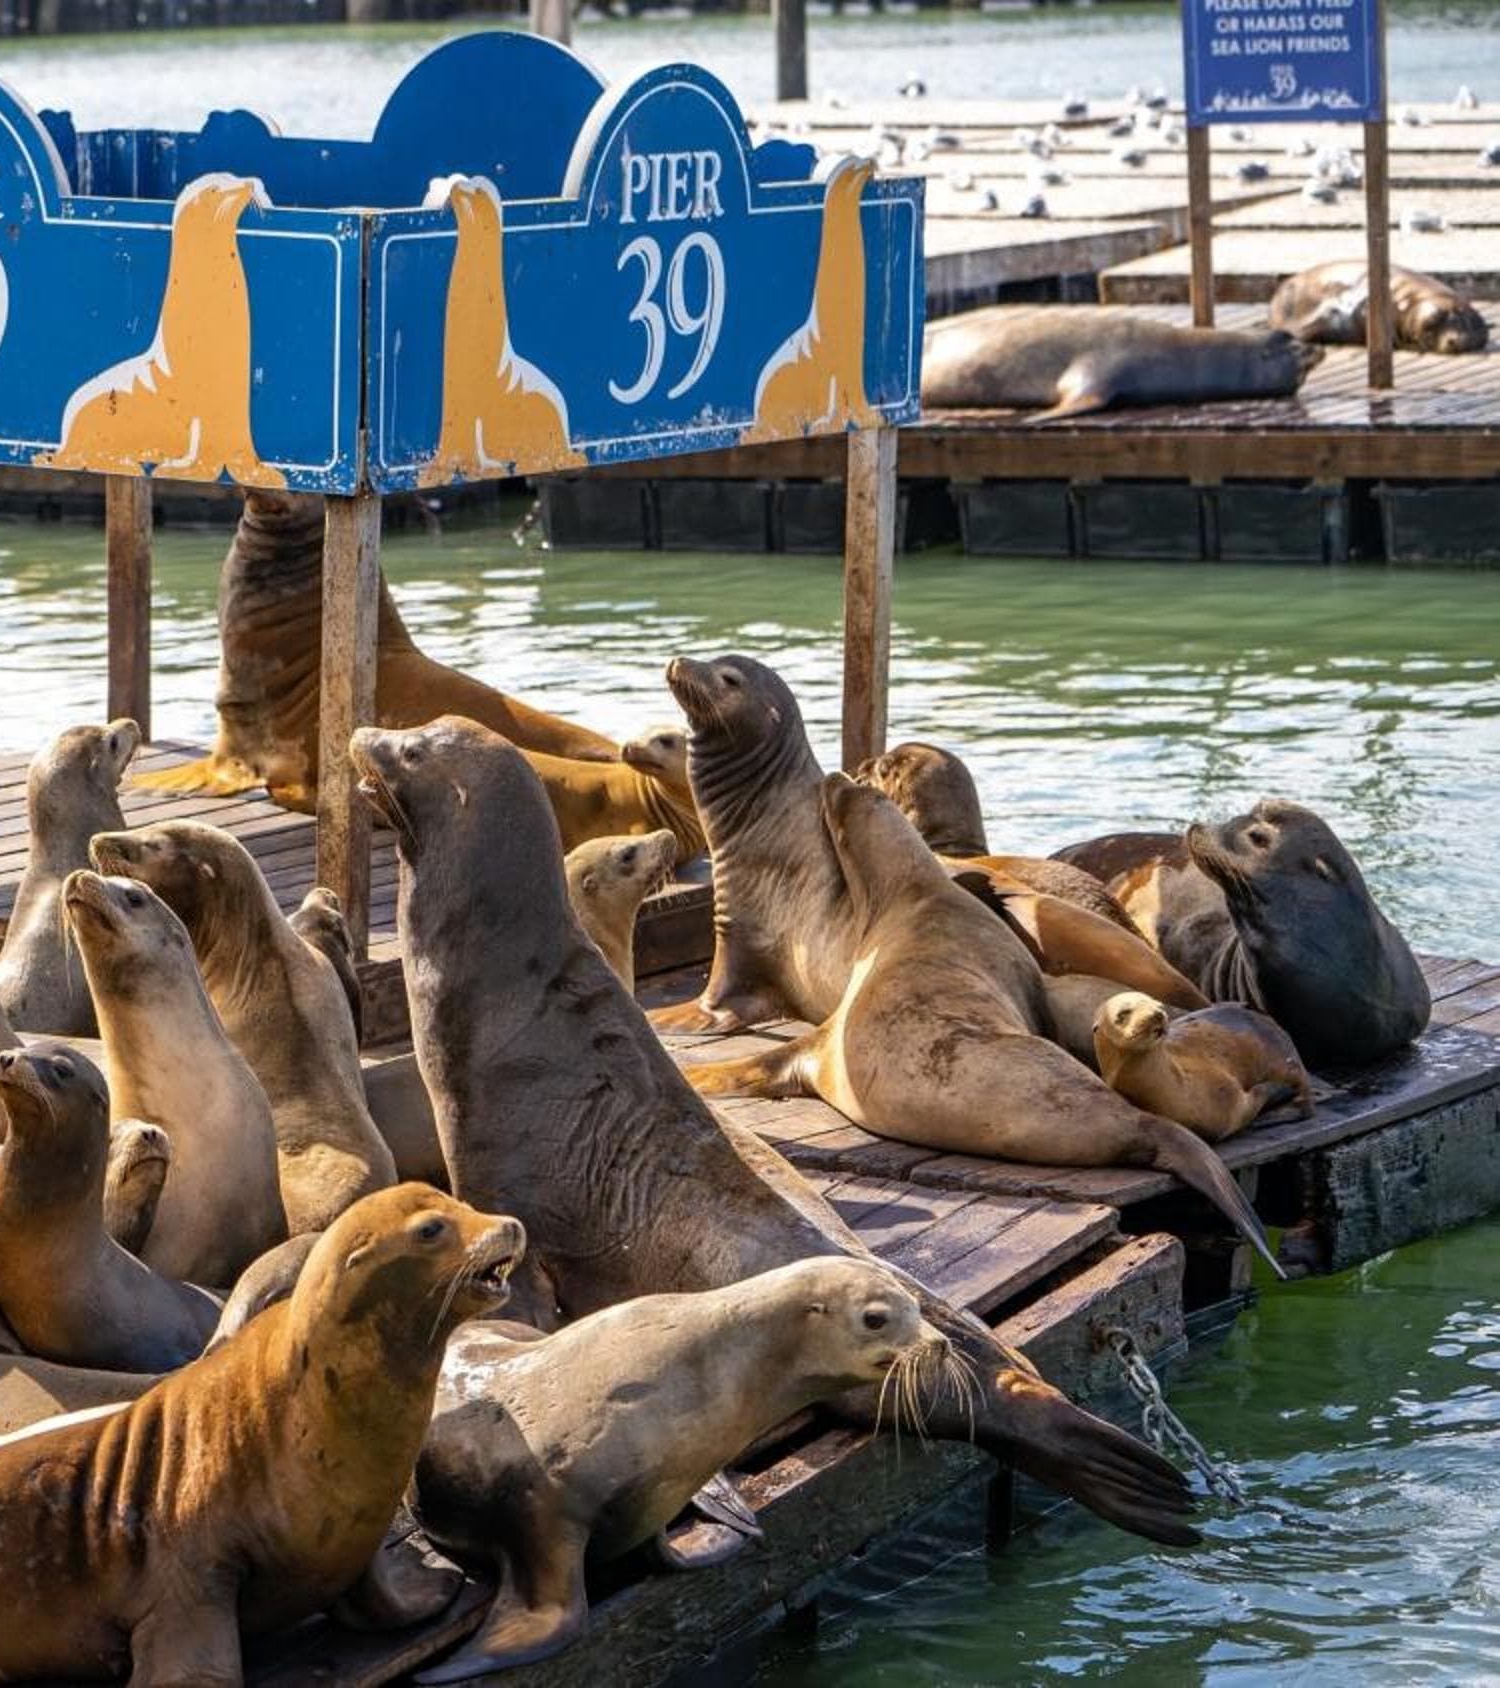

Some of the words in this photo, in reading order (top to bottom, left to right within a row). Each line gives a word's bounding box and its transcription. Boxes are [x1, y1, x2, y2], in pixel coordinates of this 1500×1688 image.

[1204, 0, 1259, 11] PLEASE
[1263, 0, 1313, 10] DON
[1215, 16, 1239, 33] OR
[1243, 15, 1305, 32] HARASS
[1309, 14, 1344, 30] OUR
[1211, 38, 1241, 56] SEA
[1244, 37, 1283, 54] LION
[1287, 34, 1350, 52] FRIENDS
[1270, 75, 1297, 98] 39
[620, 150, 725, 224] PIER
[608, 231, 726, 404] 39
